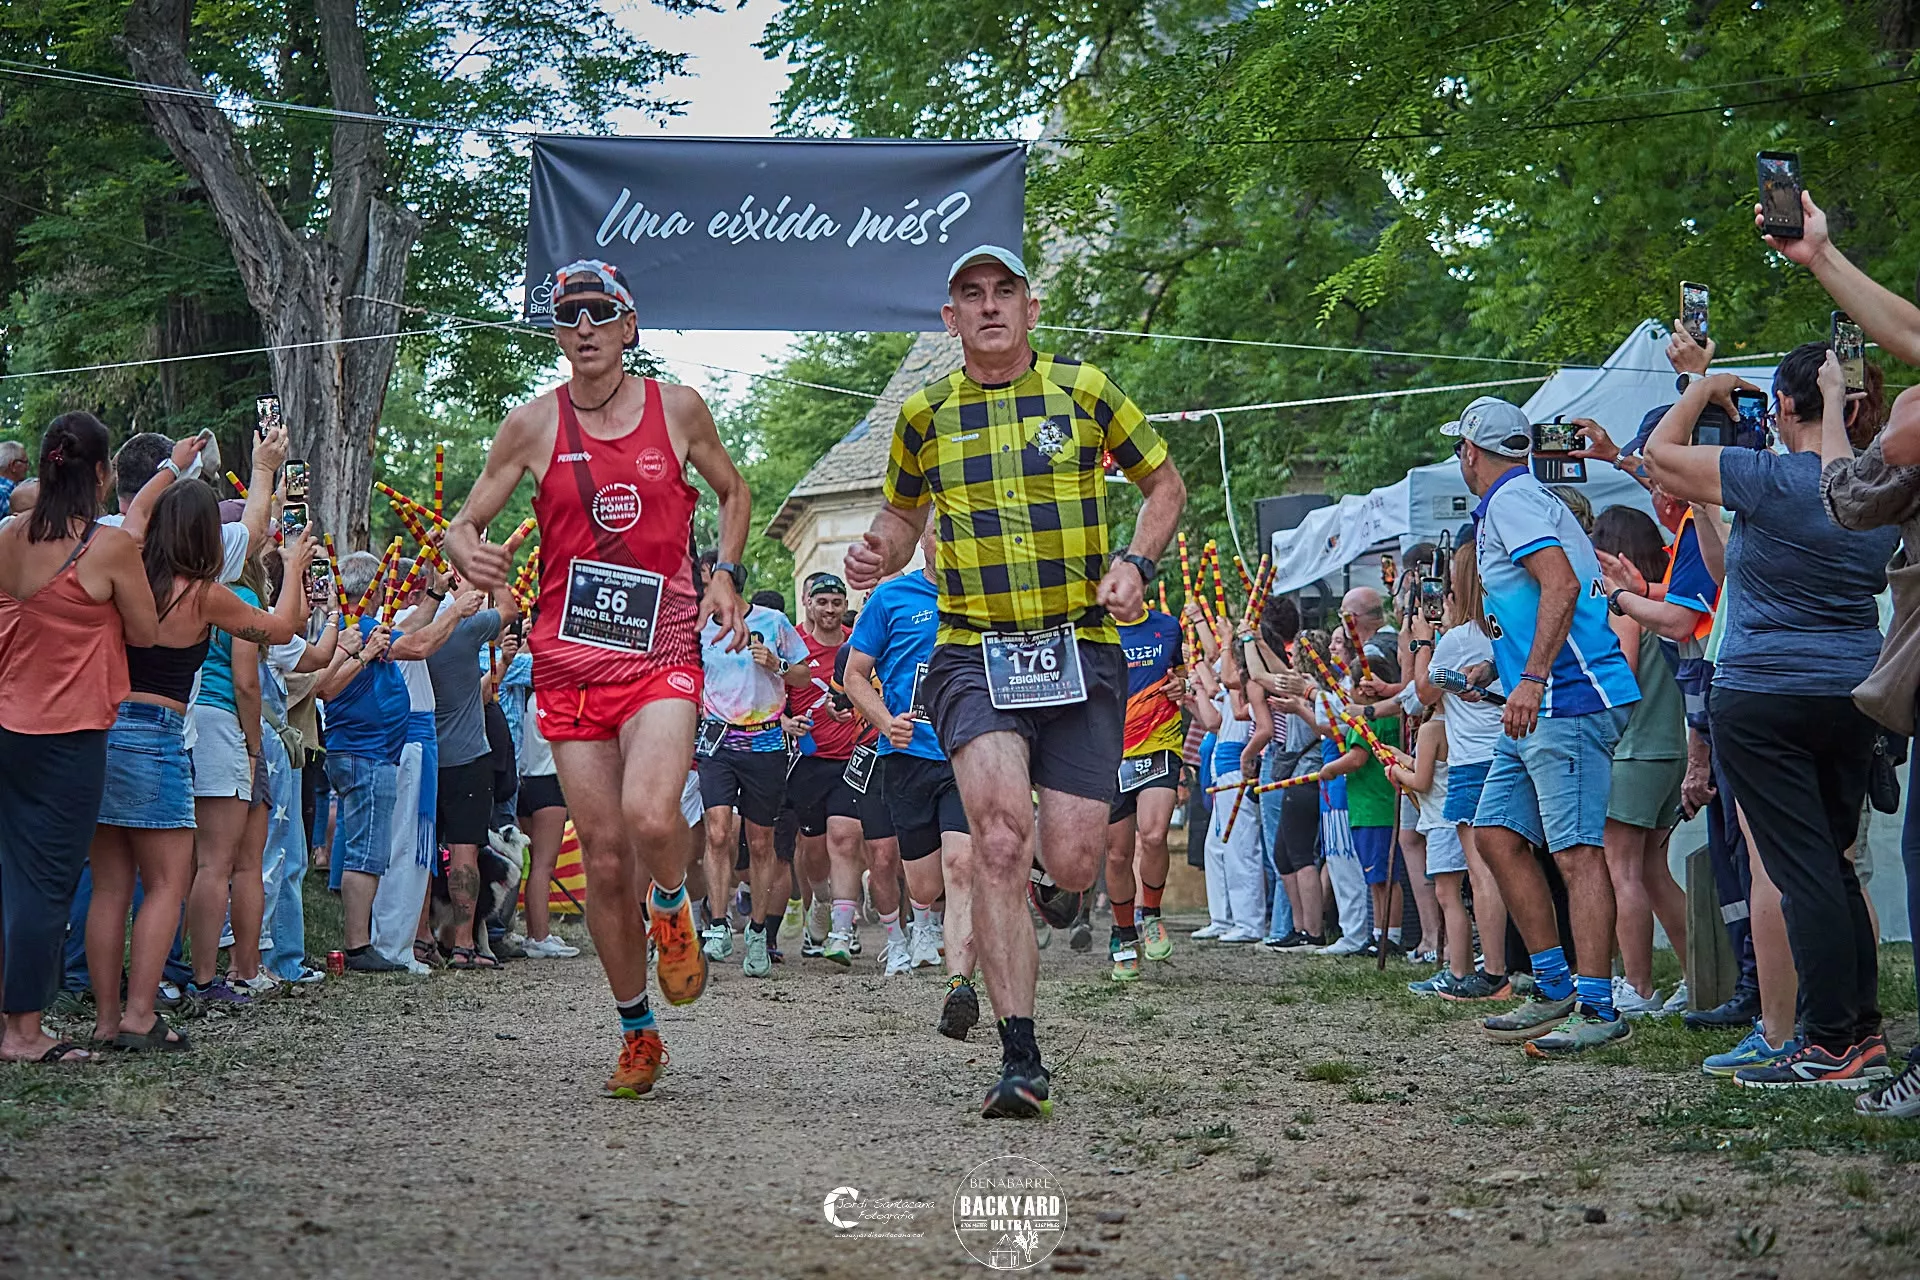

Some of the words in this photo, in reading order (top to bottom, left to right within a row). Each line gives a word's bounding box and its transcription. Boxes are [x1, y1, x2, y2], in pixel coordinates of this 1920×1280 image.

[596, 187, 695, 247] Una
[707, 194, 841, 245] eixida
[846, 191, 971, 247] més?
[530, 304, 552, 314] BEN
[600, 495, 635, 503] ATLETISMO
[594, 586, 629, 613] 56
[571, 605, 598, 620] PAKO
[598, 611, 613, 623] EL
[613, 614, 649, 630] FLAKO
[1008, 647, 1058, 674] 176
[1008, 671, 1061, 686] ZBIGNIEW
